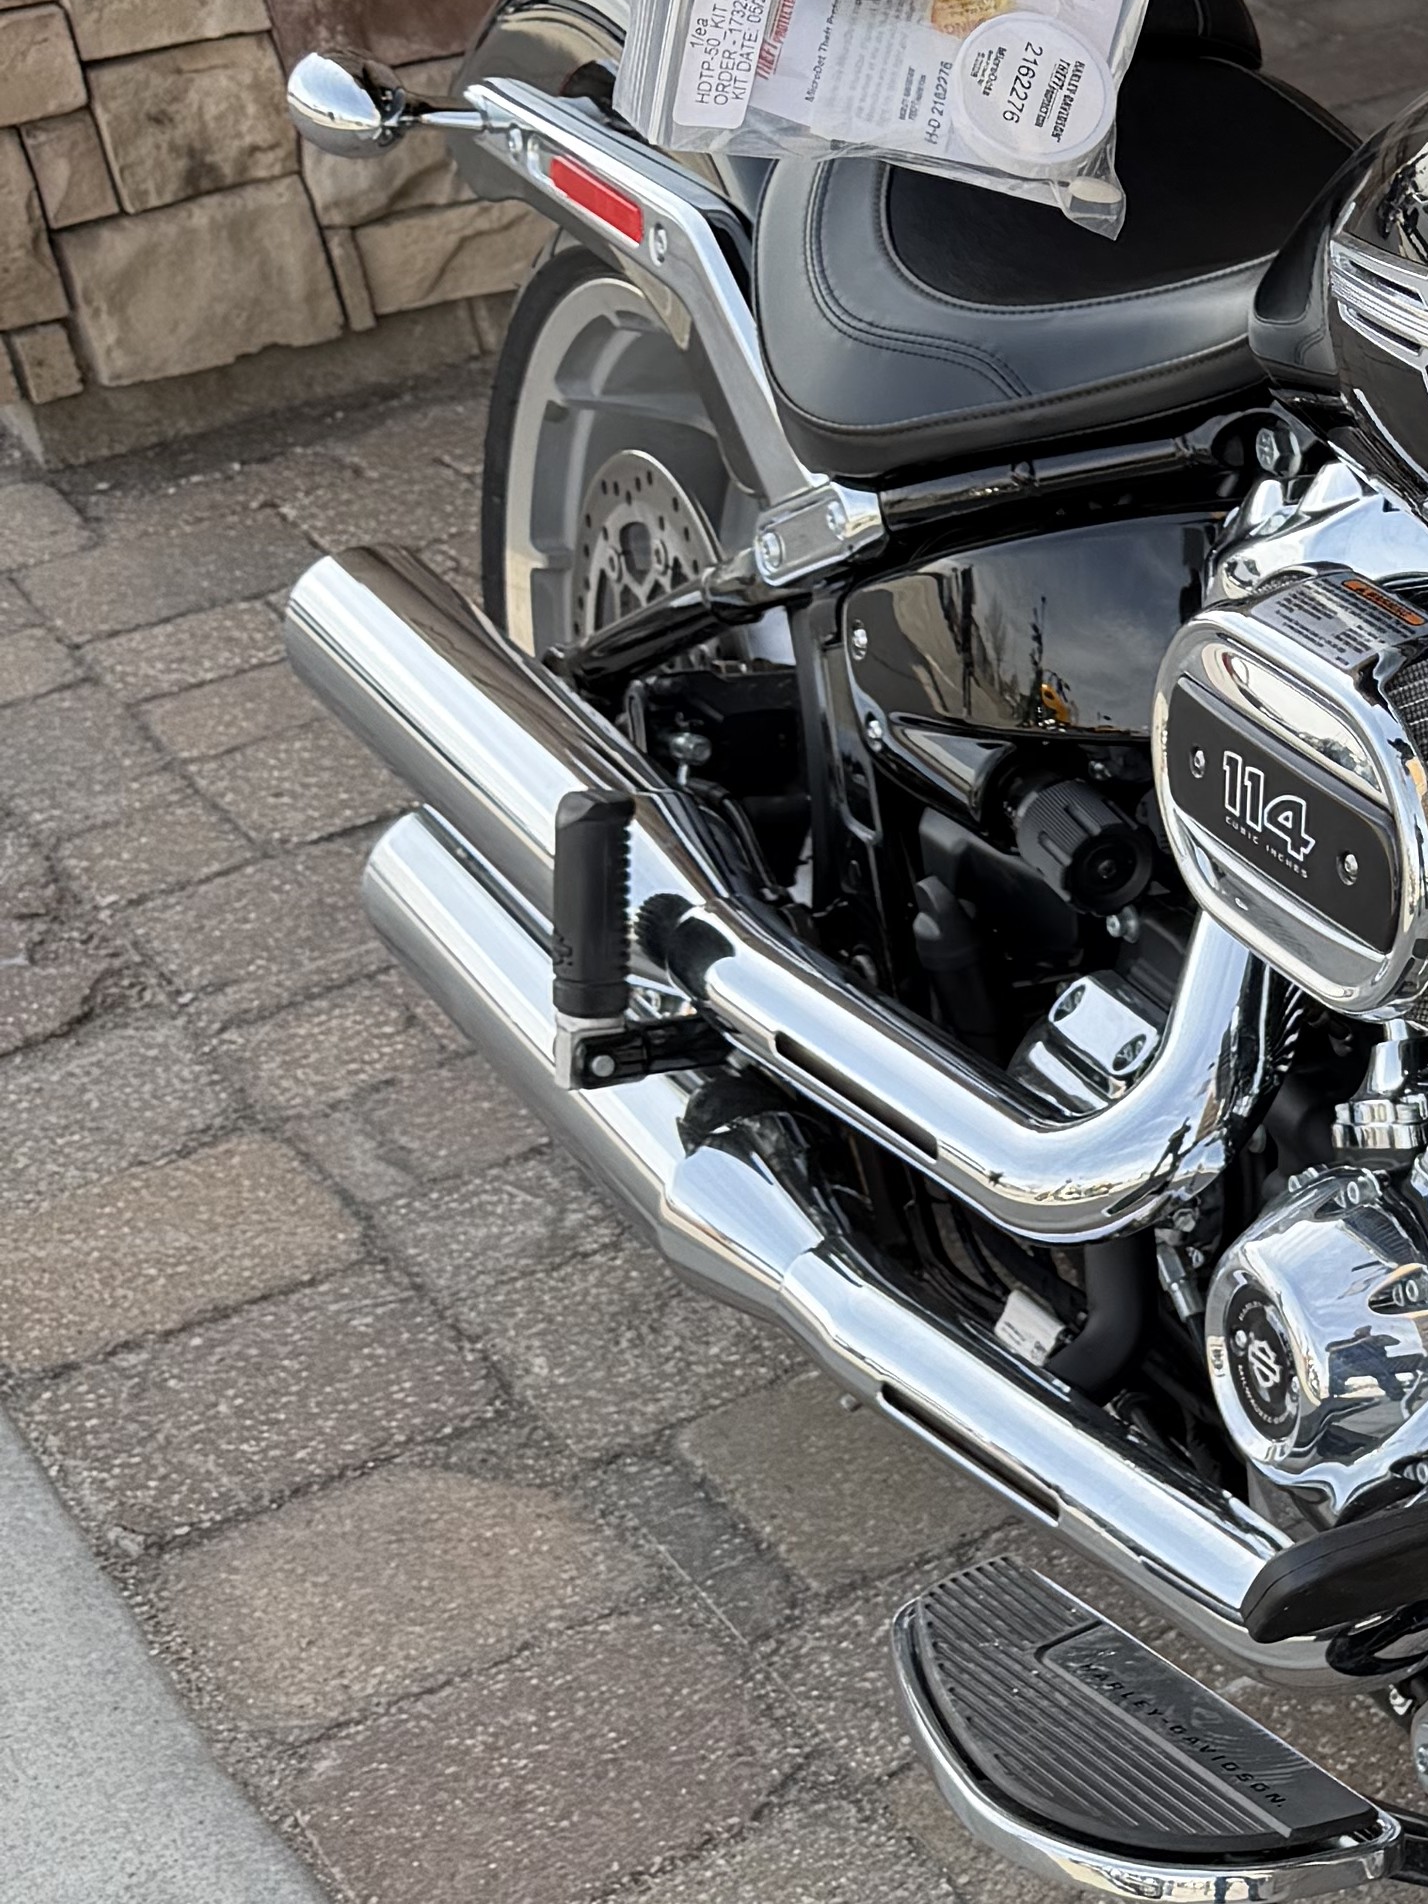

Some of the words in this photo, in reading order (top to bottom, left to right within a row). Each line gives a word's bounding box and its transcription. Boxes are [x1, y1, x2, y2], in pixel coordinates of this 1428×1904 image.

[688, 15, 709, 50] 1/ea
[693, 2, 730, 105] HDTP-50_KIT
[735, 26, 759, 72] DATE:
[712, 48, 738, 106] ORDER
[730, 76, 748, 100] KIT
[804, 53, 826, 103] MicroDot
[1001, 41, 1044, 124] 2162276
[1223, 747, 1316, 861] 114
[1225, 814, 1260, 845] CUBIC
[1265, 844, 1309, 879] INCHES
